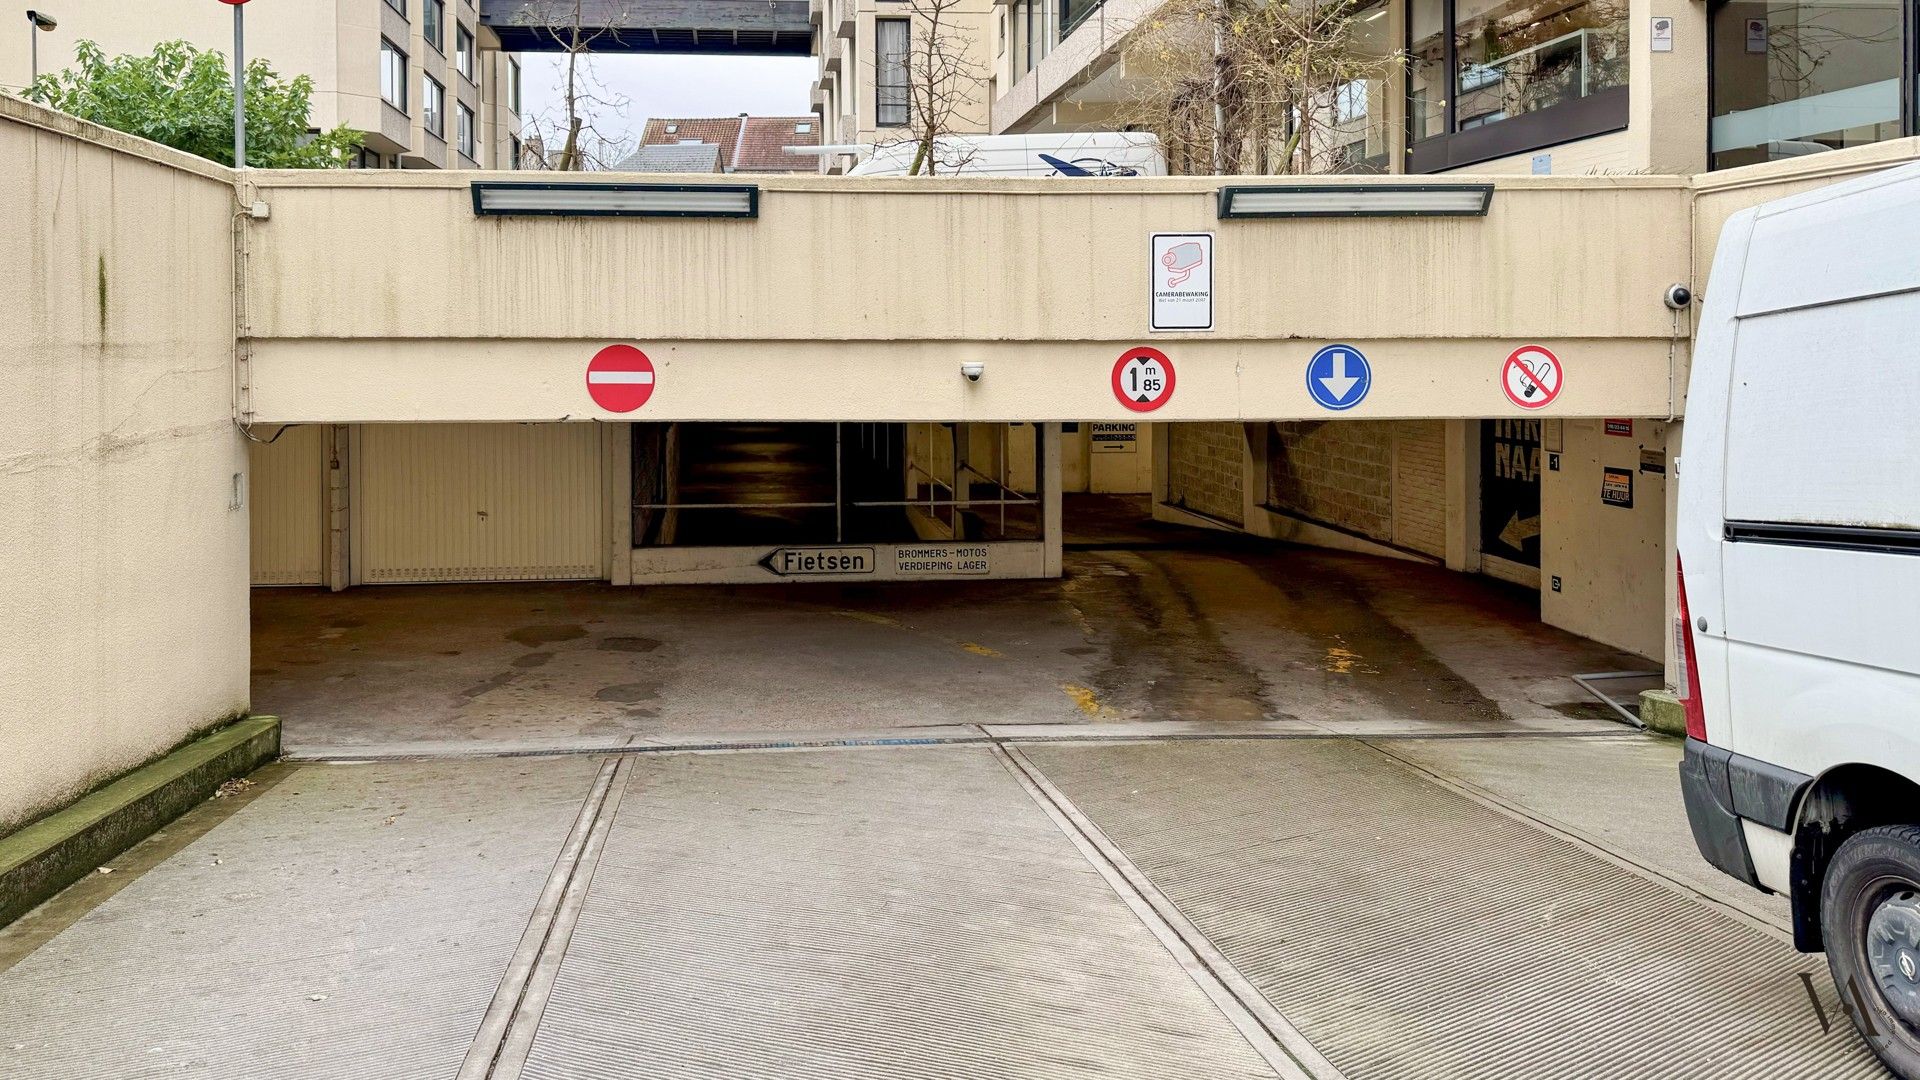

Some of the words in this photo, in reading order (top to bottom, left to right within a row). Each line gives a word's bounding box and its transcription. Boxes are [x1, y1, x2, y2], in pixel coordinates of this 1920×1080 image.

[1145, 367, 1156, 375] m
[1130, 367, 1137, 391] 1
[1143, 379, 1161, 391] 85
[1092, 423, 1135, 431] PARKING
[784, 552, 864, 570] Fietsen
[898, 561, 953, 570] VERDIEPING
[957, 561, 987, 570] LAGER
